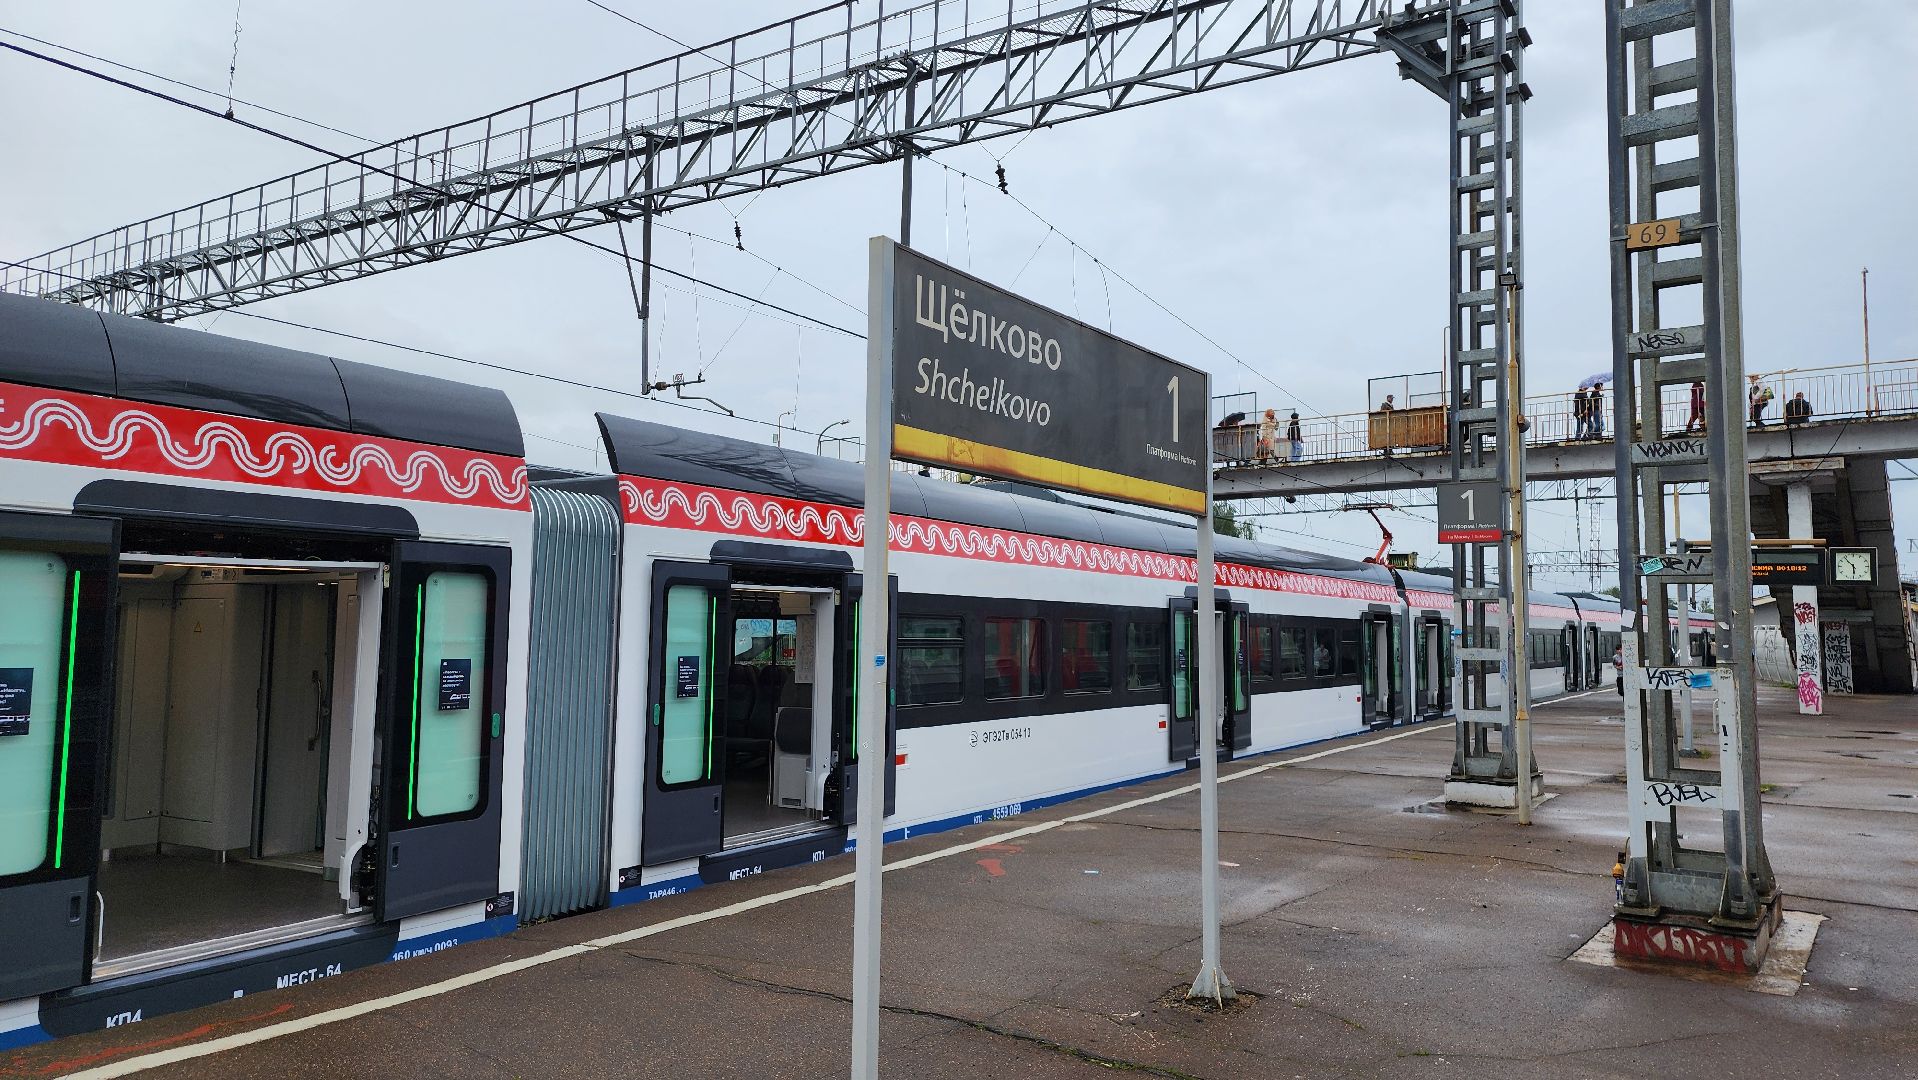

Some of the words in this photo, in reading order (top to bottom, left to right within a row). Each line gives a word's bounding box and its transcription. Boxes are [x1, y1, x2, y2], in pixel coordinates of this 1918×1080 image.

[1641, 225, 1665, 243] 69
[916, 274, 1062, 371] Щёлково
[915, 357, 1051, 427] Shchelkovo
[1167, 375, 1179, 443] 1
[1460, 489, 1475, 521] 1
